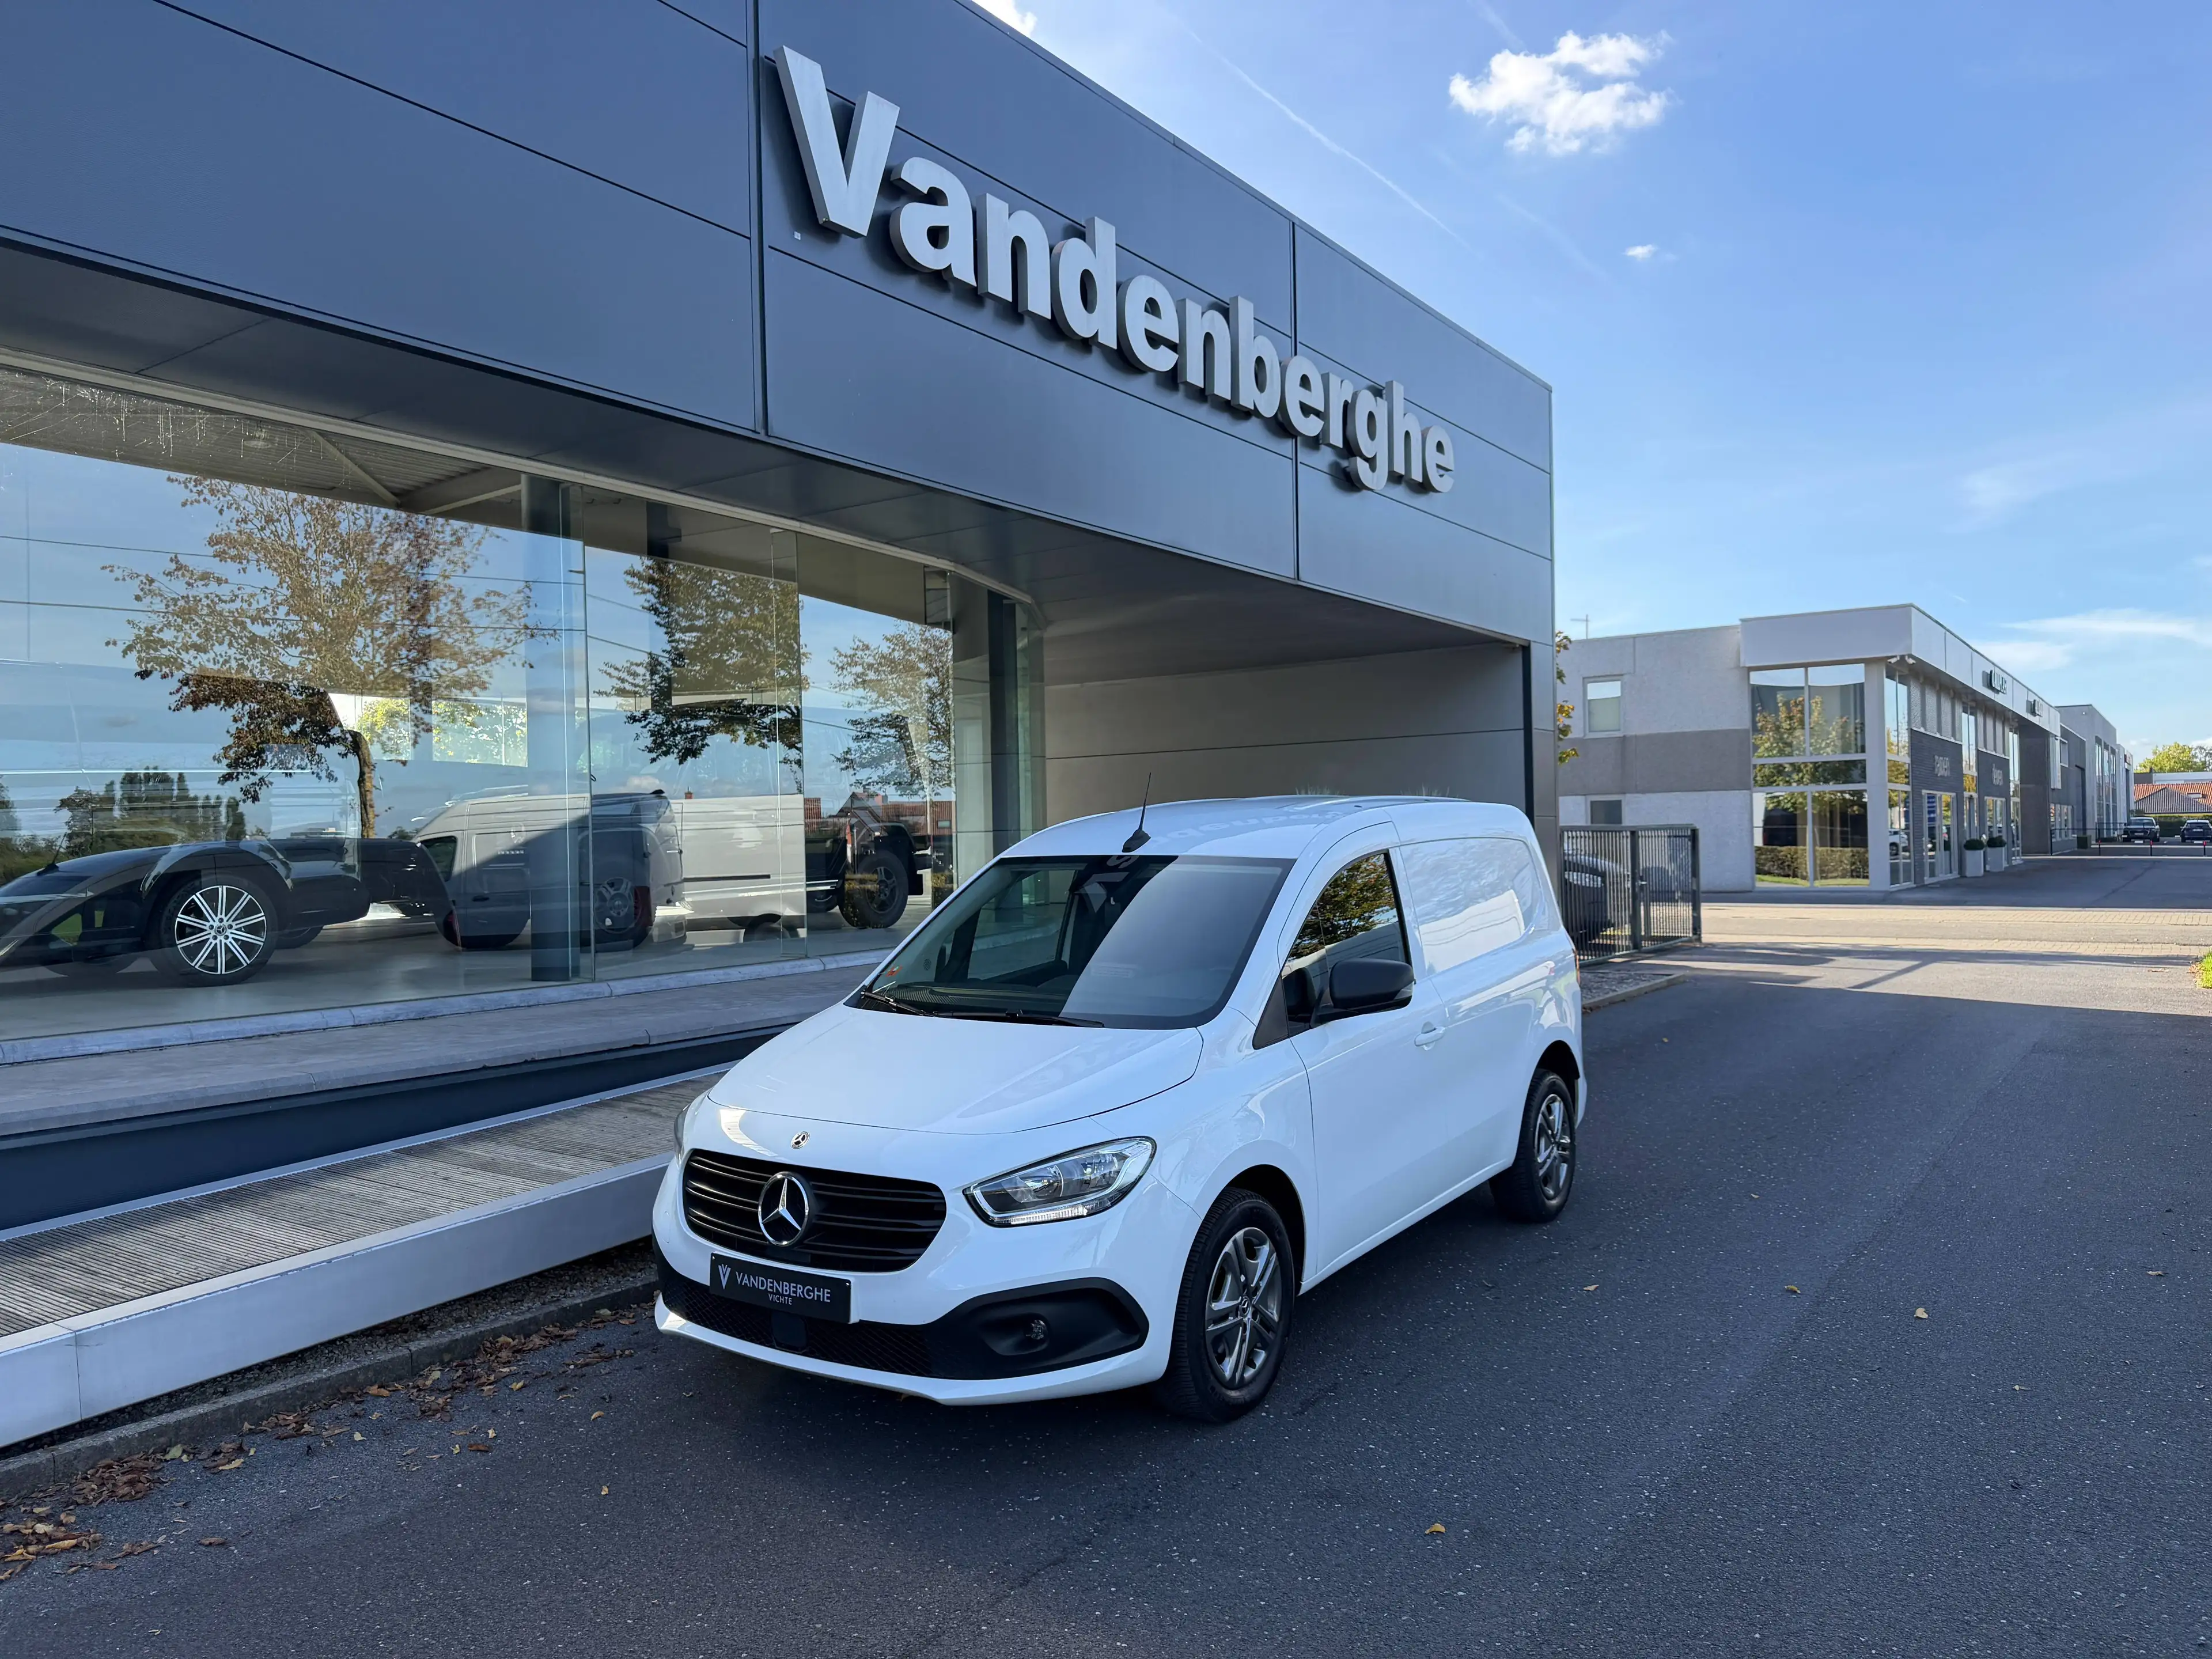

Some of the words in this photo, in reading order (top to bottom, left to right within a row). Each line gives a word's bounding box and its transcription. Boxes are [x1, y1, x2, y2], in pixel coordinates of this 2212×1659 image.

[773, 46, 1455, 494] Vandenberghe
[735, 1271, 831, 1303] VANDENBERGHE
[768, 1293, 793, 1305] VICHTE
